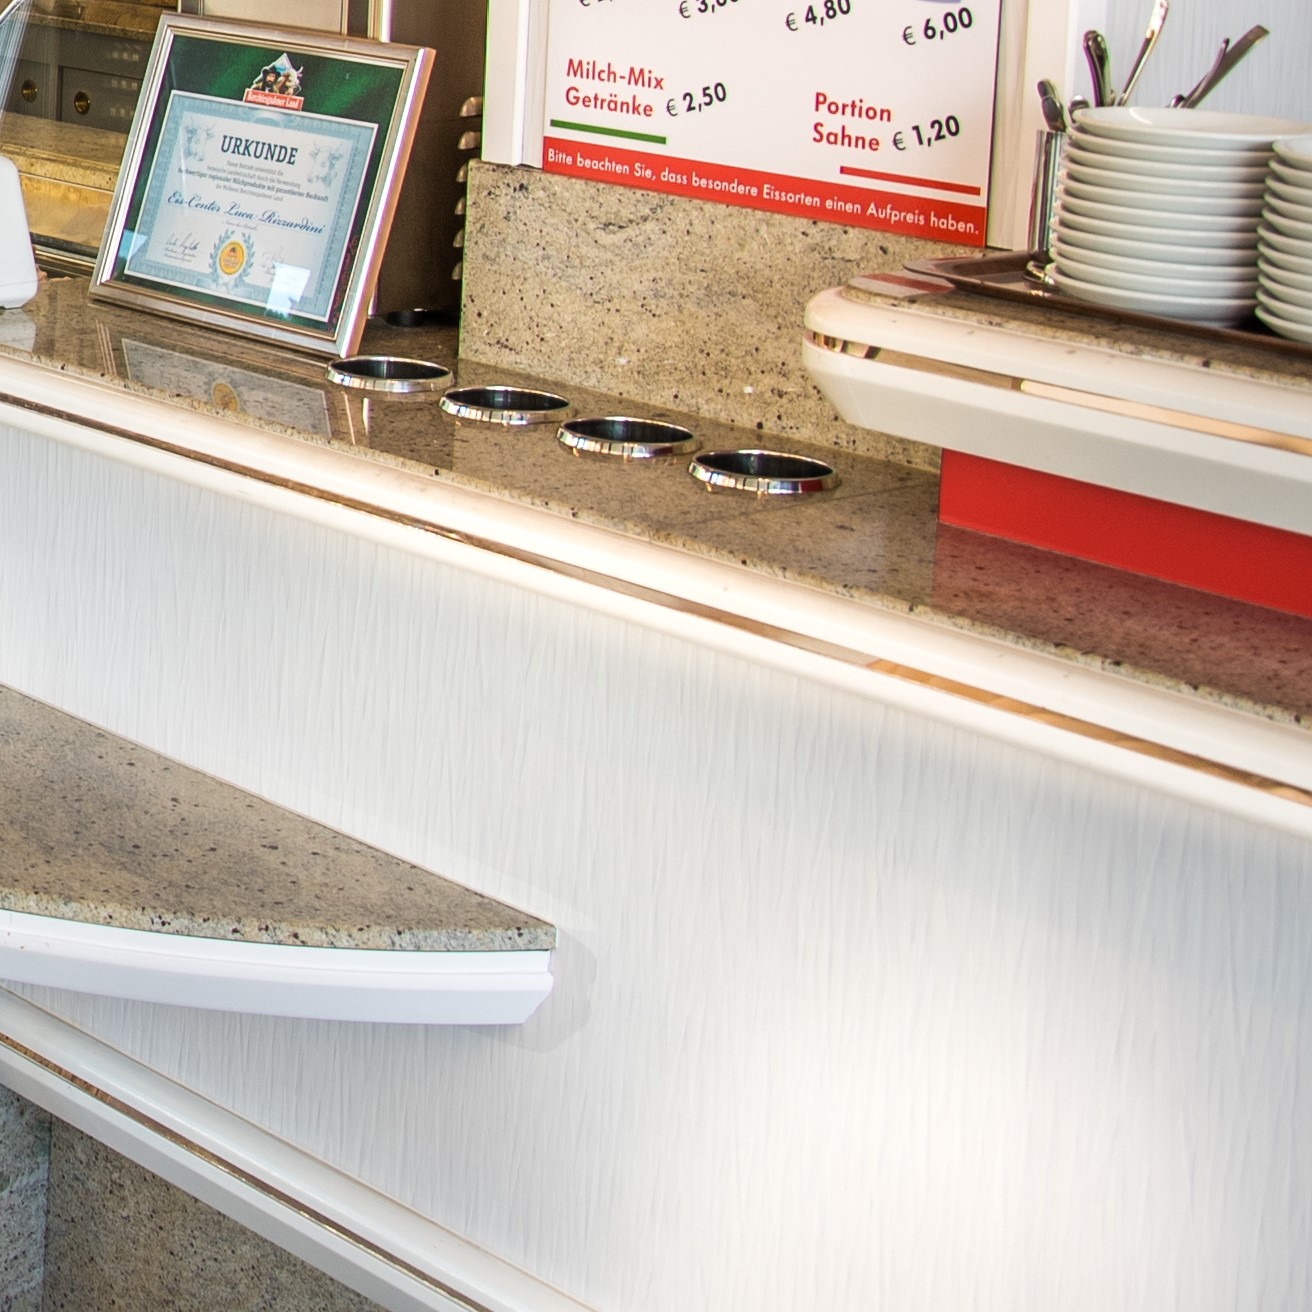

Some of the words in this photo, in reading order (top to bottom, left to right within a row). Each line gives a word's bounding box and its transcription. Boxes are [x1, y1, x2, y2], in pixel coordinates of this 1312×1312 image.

[923, 7, 973, 42] 6,00
[566, 59, 664, 90] Milch-Mix
[565, 87, 654, 118] Getränke
[682, 82, 727, 115] 2,50
[814, 93, 892, 122] Portion
[812, 122, 881, 152] Sahne
[912, 115, 960, 148] 1,20
[221, 135, 298, 165] URKUNDE
[547, 149, 573, 167] Bitte
[577, 153, 630, 175] beachten
[634, 163, 656, 180] Sie,
[660, 167, 688, 186] dass
[692, 171, 758, 197] besondere
[763, 184, 820, 207] Eissorten
[825, 195, 861, 215] einen
[866, 201, 925, 226] Aufpreis
[930, 211, 979, 235] haben.
[224, 202, 254, 220] Luca
[258, 209, 325, 234] Rizzardini
